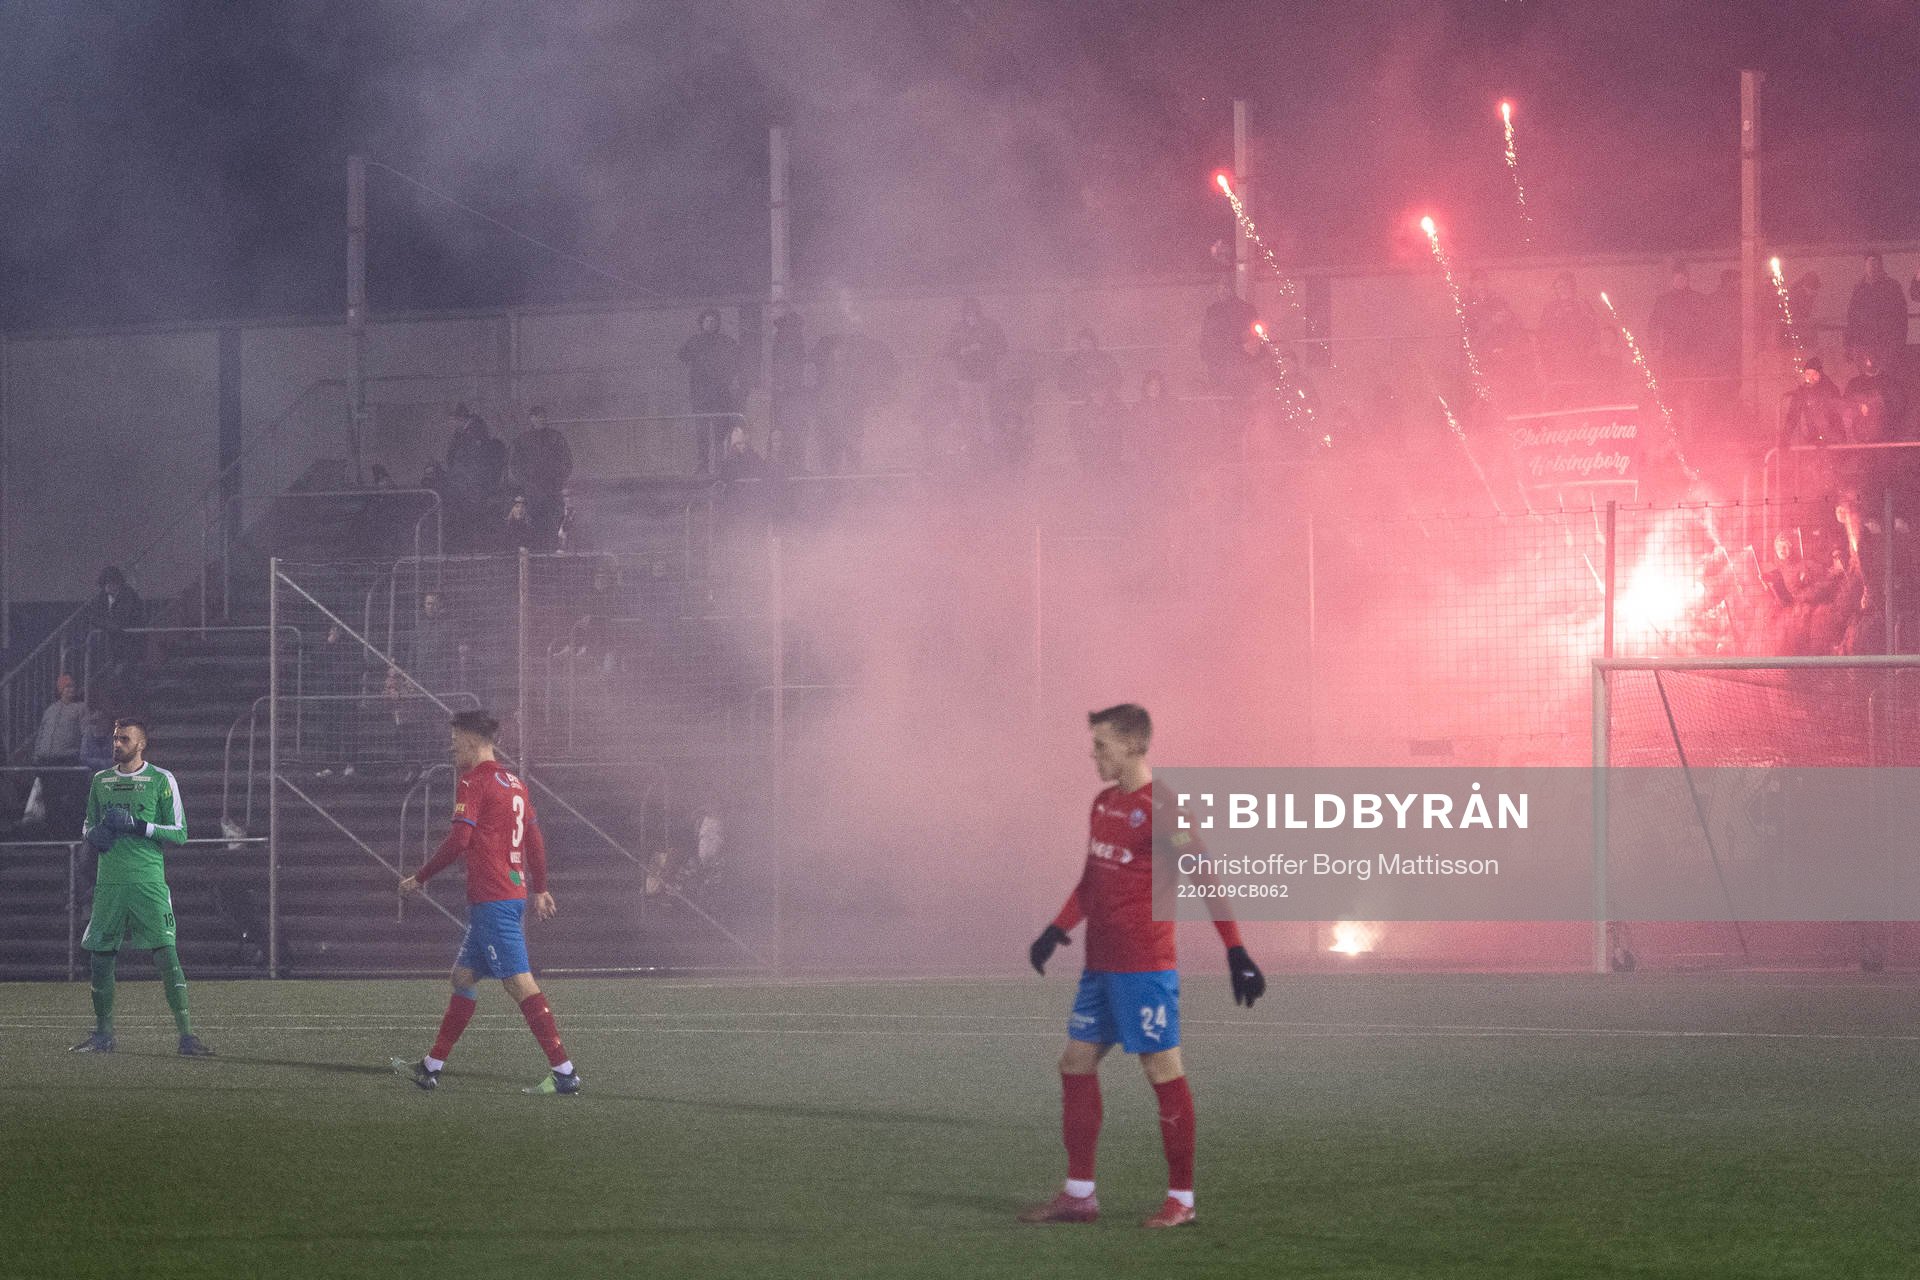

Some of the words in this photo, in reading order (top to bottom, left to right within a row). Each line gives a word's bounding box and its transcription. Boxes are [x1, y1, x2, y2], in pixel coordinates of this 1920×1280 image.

[512, 795, 524, 847] 3
[162, 912, 175, 928] 18
[487, 944, 498, 961] 3
[1140, 1004, 1168, 1032] 24
